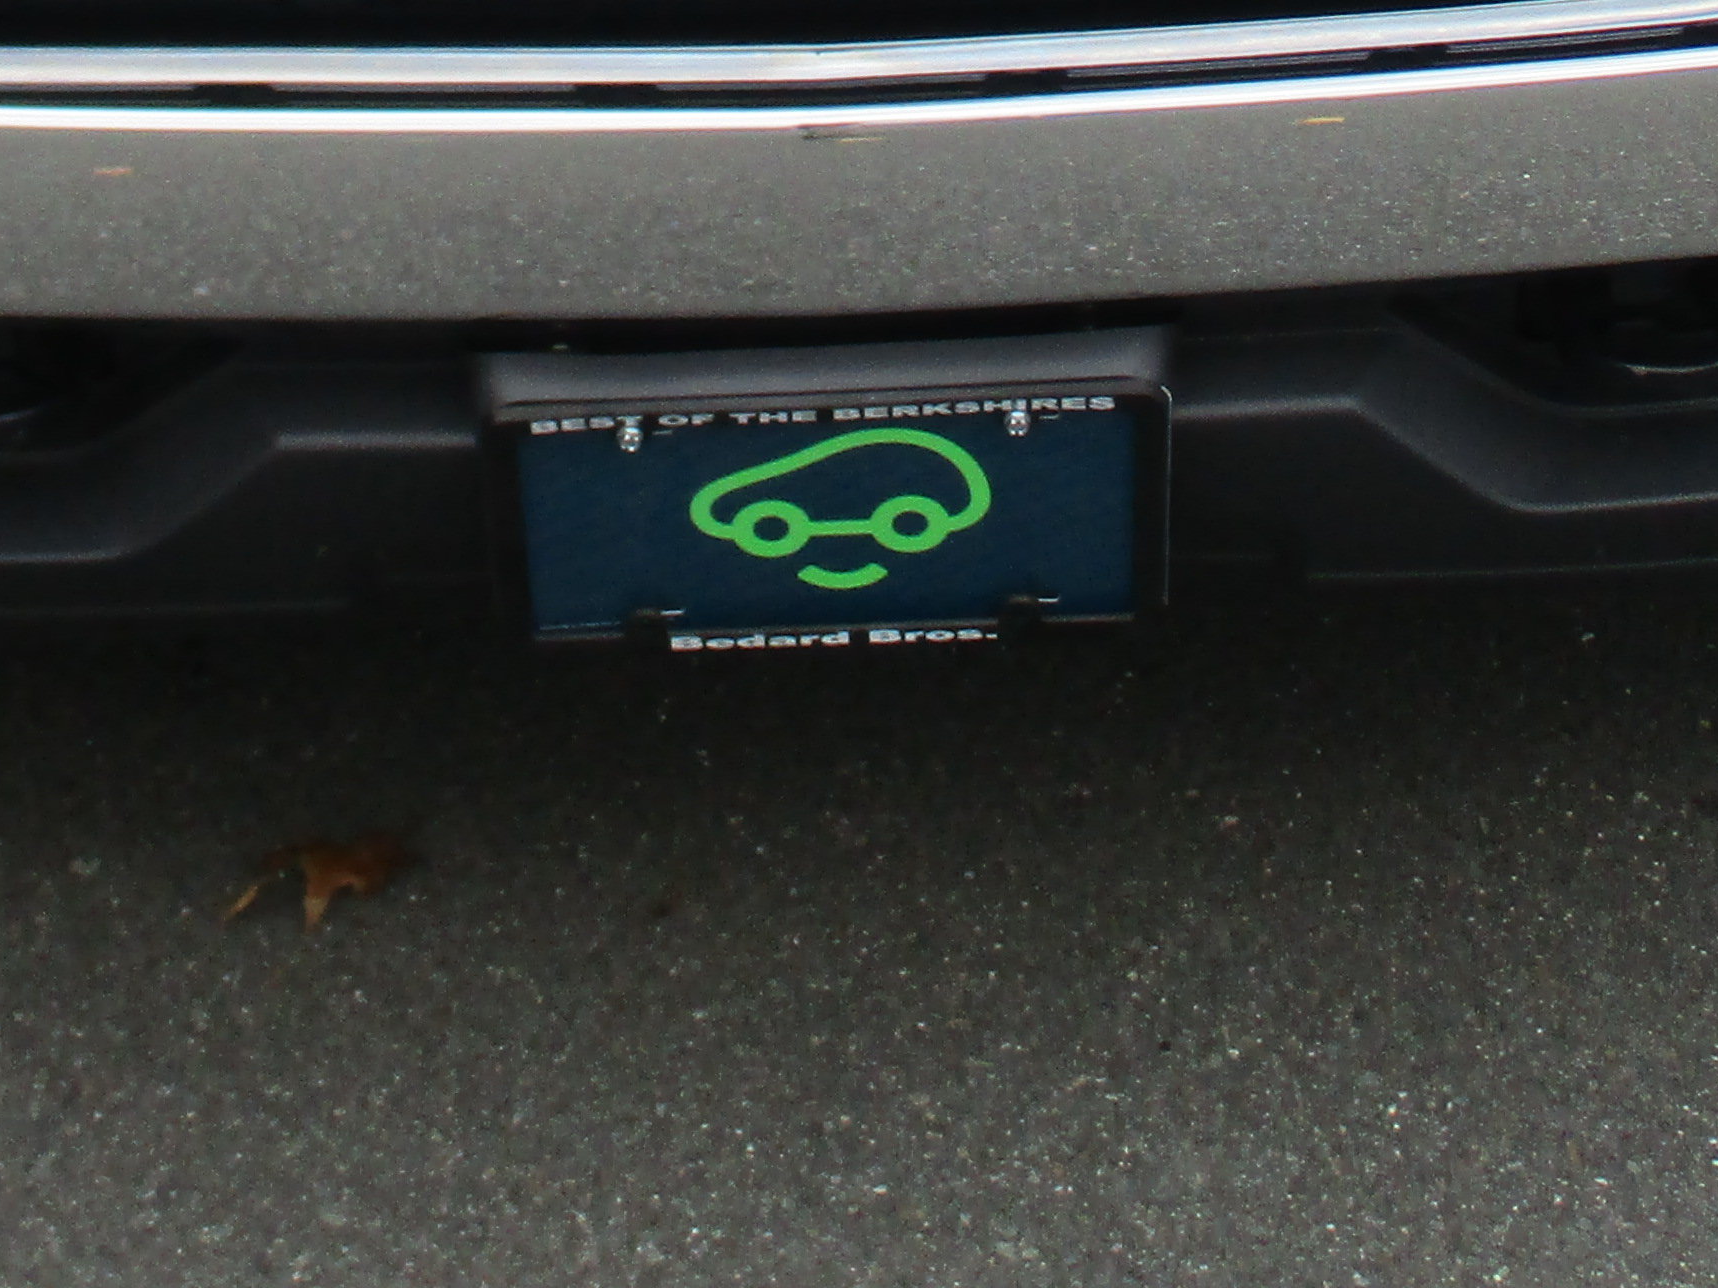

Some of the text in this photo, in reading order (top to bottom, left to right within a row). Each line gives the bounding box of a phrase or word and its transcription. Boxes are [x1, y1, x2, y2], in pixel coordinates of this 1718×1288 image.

[658, 413, 714, 425] OF
[729, 410, 817, 424] THE
[833, 396, 1116, 421] BERKSHIRES
[670, 630, 850, 651] Bedard
